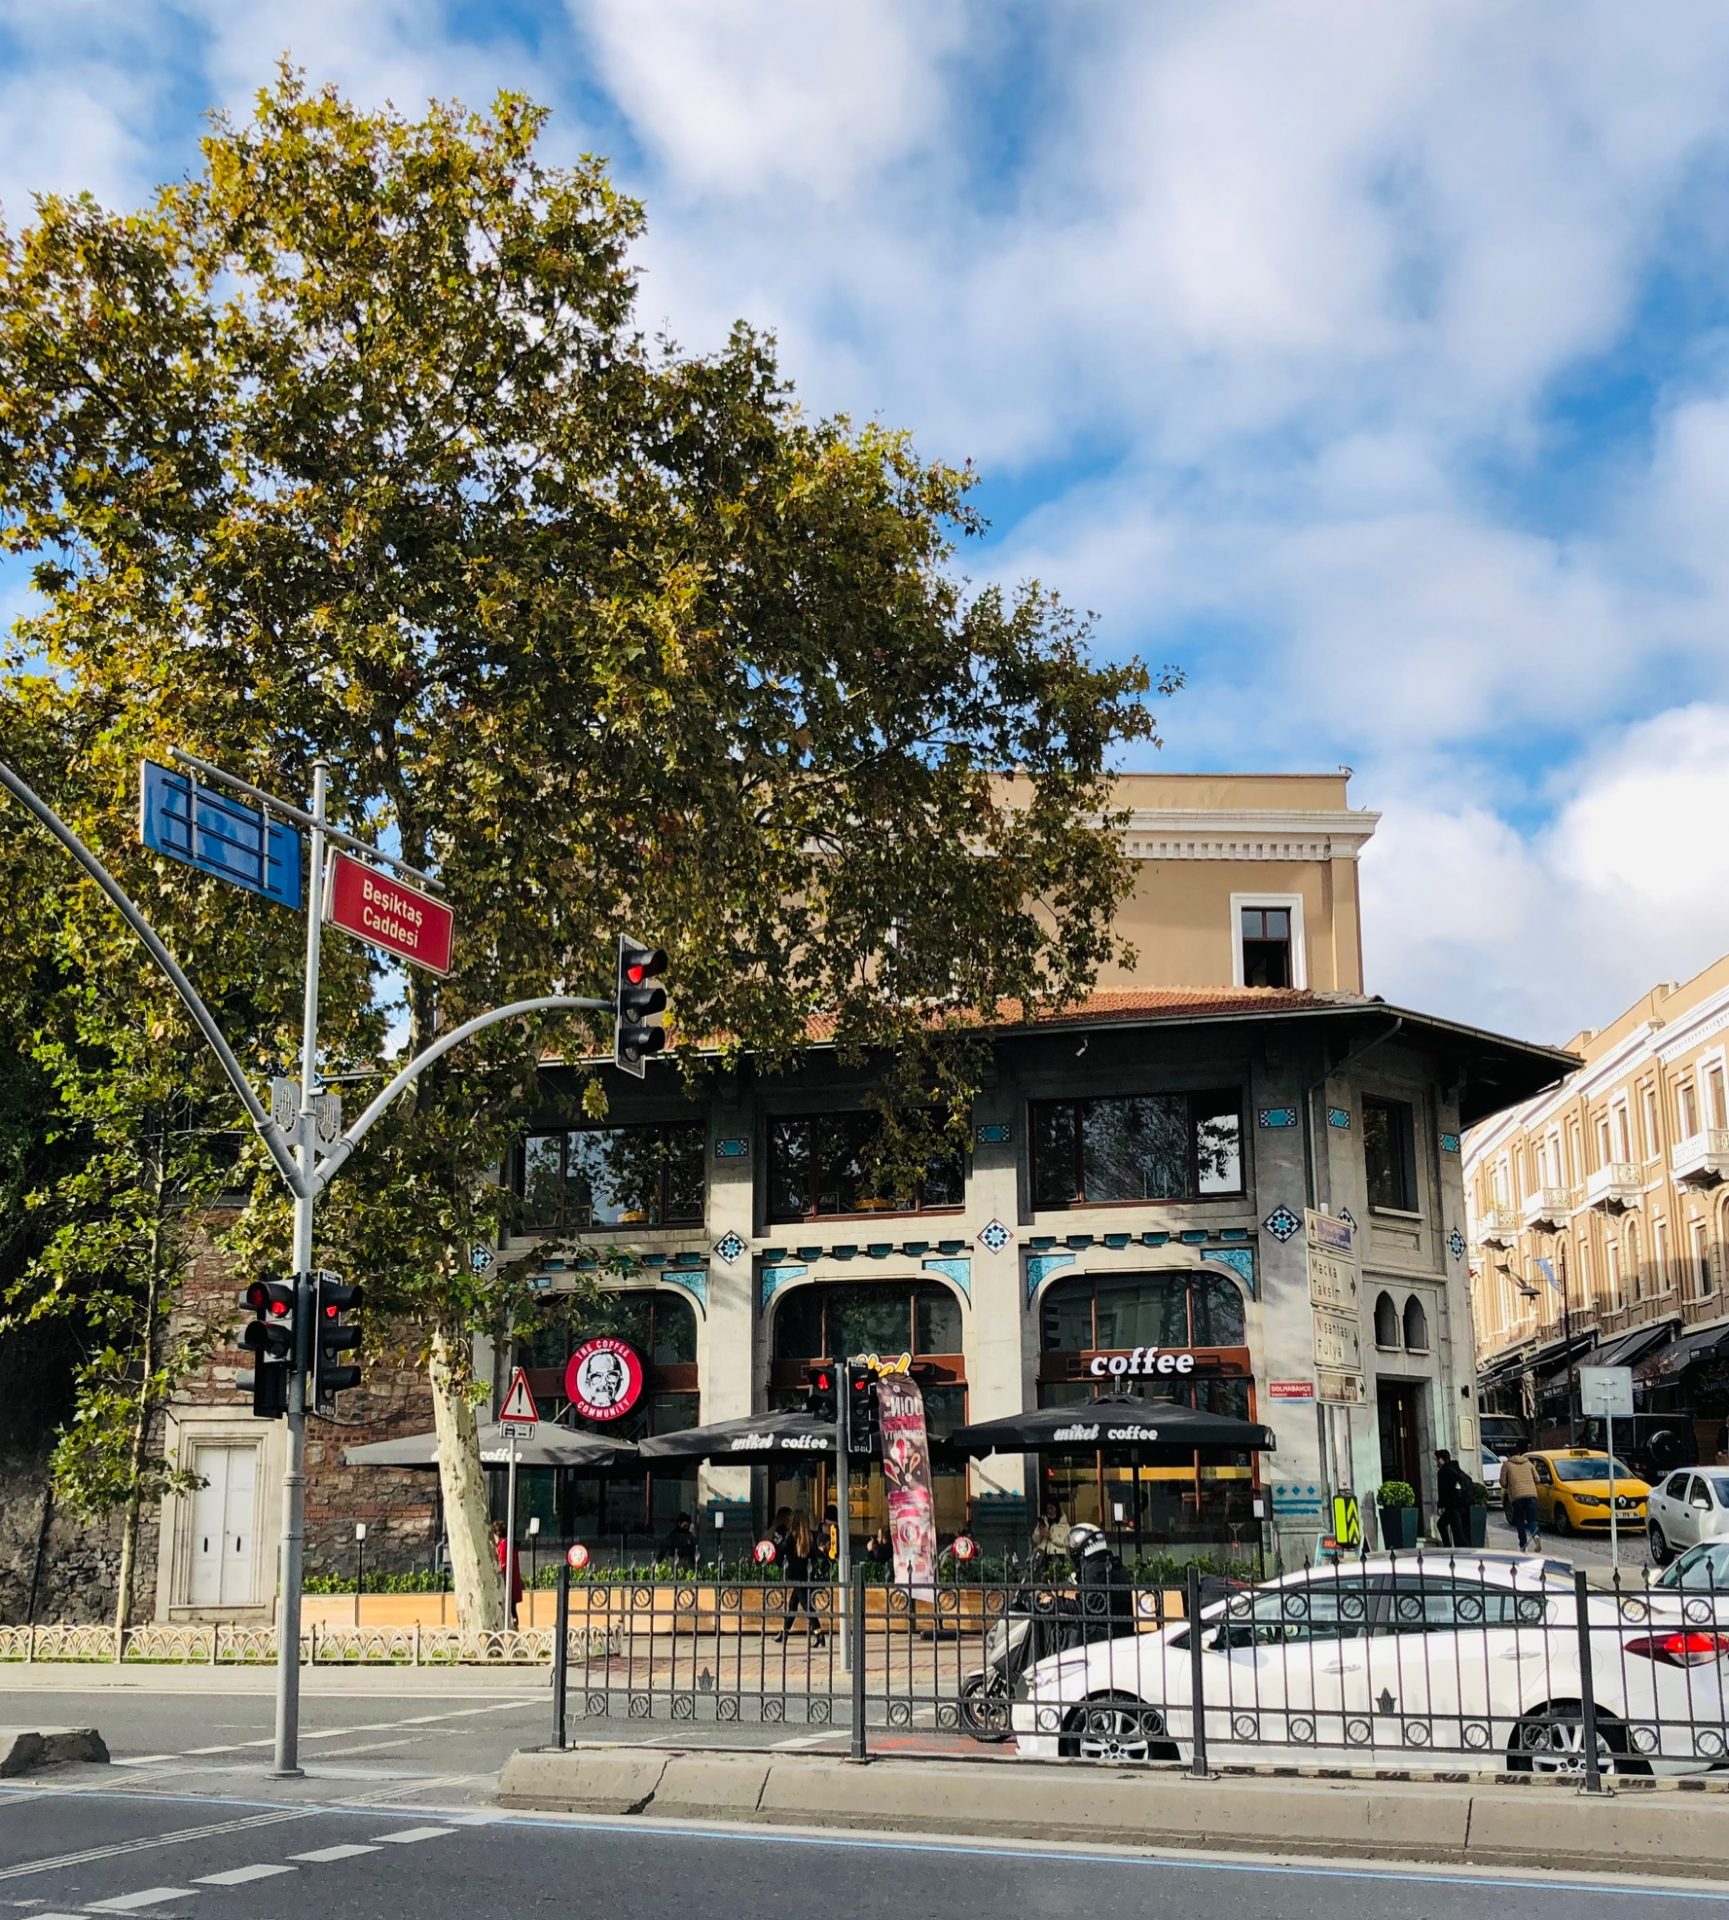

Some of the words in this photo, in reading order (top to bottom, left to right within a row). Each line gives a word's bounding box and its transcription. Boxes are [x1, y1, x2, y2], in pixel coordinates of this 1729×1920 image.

[363, 880, 422, 928] Beşiktaş
[363, 906, 419, 948] Caddesi
[576, 1344, 593, 1359] THE
[596, 1340, 630, 1358] COFFEE
[1090, 1347, 1194, 1376] coffee
[577, 1398, 630, 1418] COMMUNITY
[781, 1434, 828, 1449] coffee
[1107, 1425, 1158, 1440] coffee
